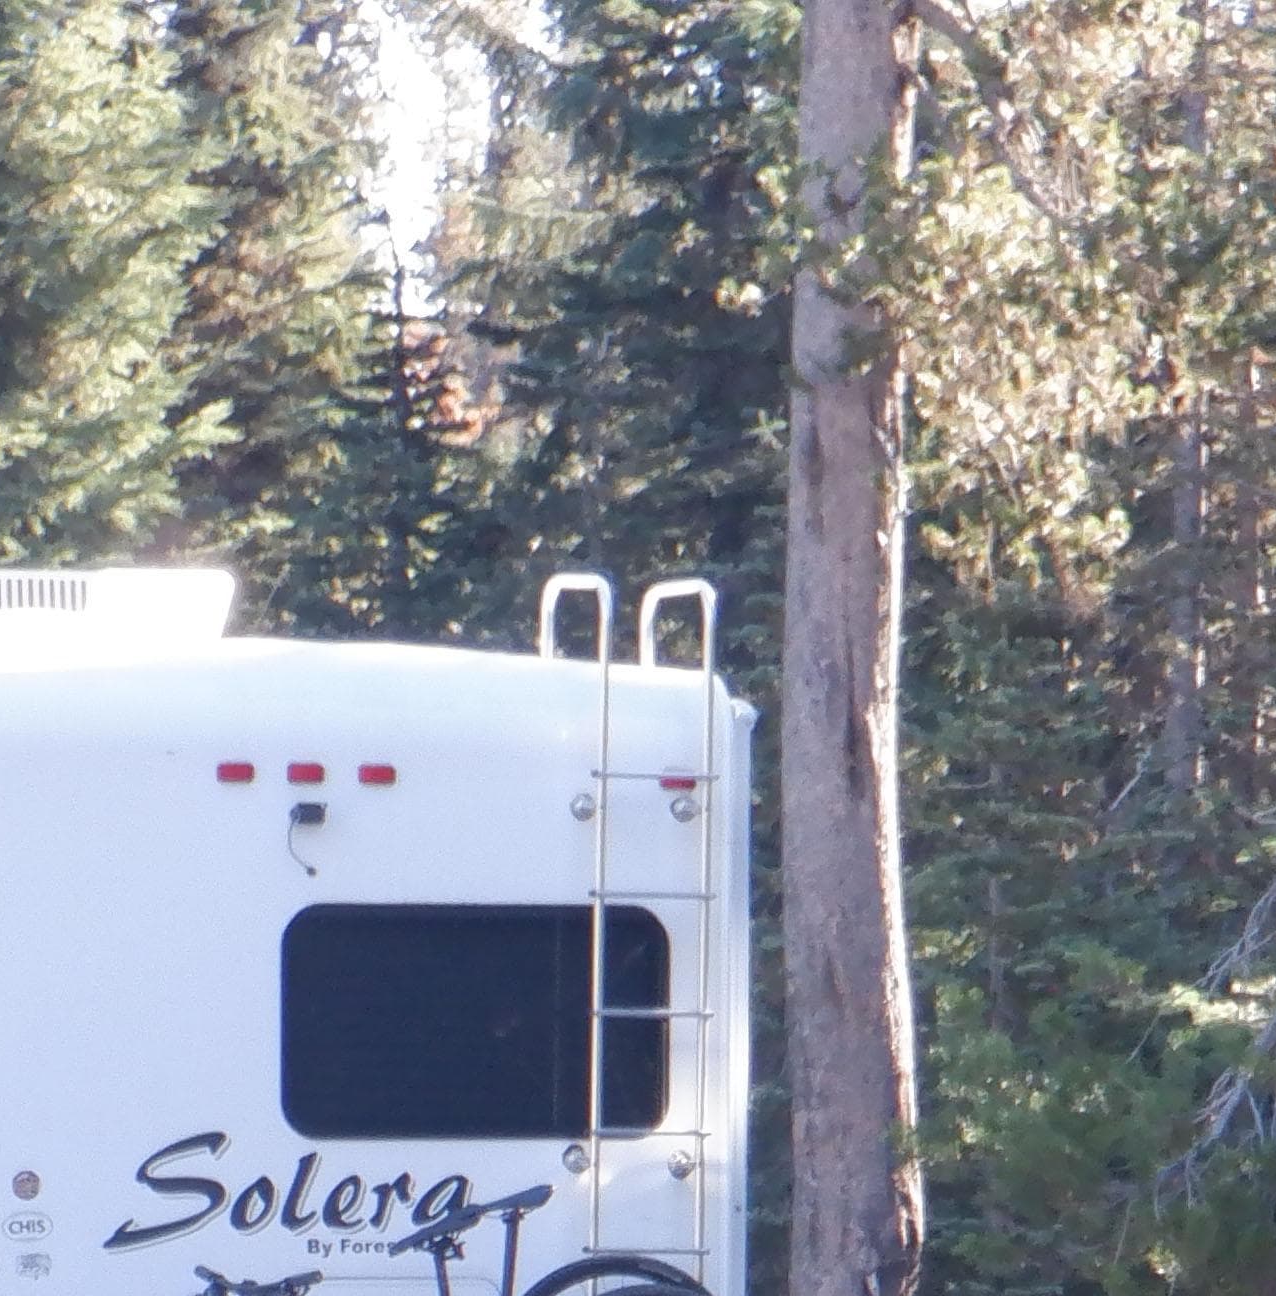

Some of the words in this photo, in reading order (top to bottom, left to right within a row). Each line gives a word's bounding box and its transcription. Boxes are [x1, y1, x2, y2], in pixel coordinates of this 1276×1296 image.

[103, 1130, 475, 1253] Solera
[8, 1219, 46, 1235] CHIS
[307, 1238, 333, 1259] By
[340, 1238, 399, 1255] Fores
